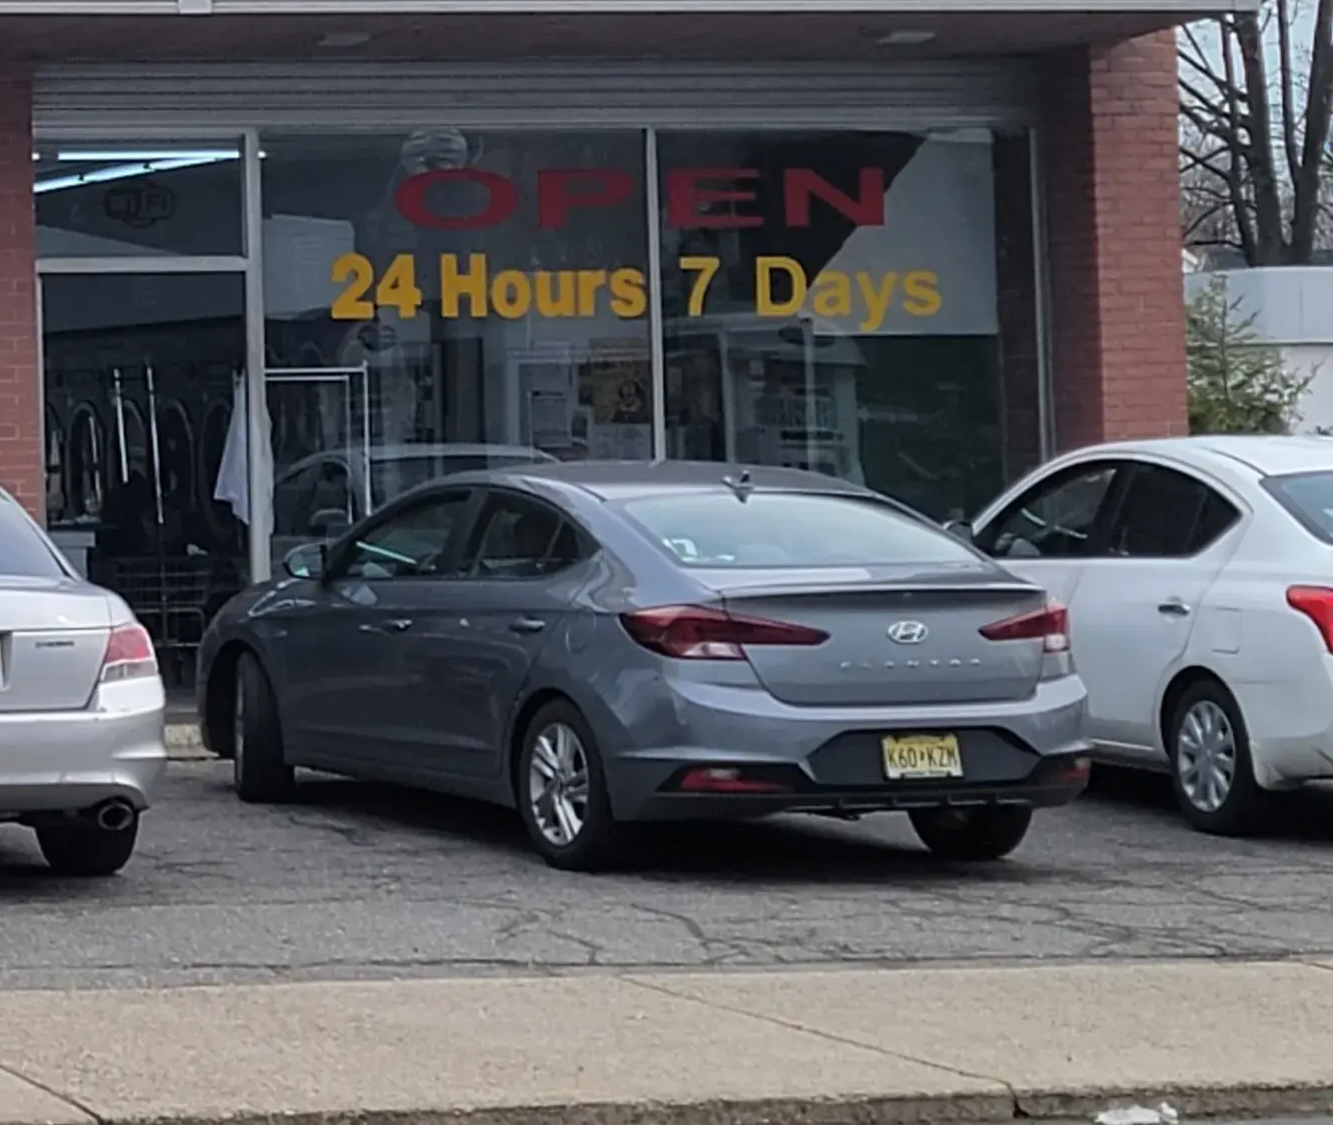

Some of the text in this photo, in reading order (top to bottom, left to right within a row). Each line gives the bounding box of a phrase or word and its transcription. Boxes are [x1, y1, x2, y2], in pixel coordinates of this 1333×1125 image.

[395, 166, 886, 229] OPEN
[330, 253, 942, 332] 24 Hours 7 Days
